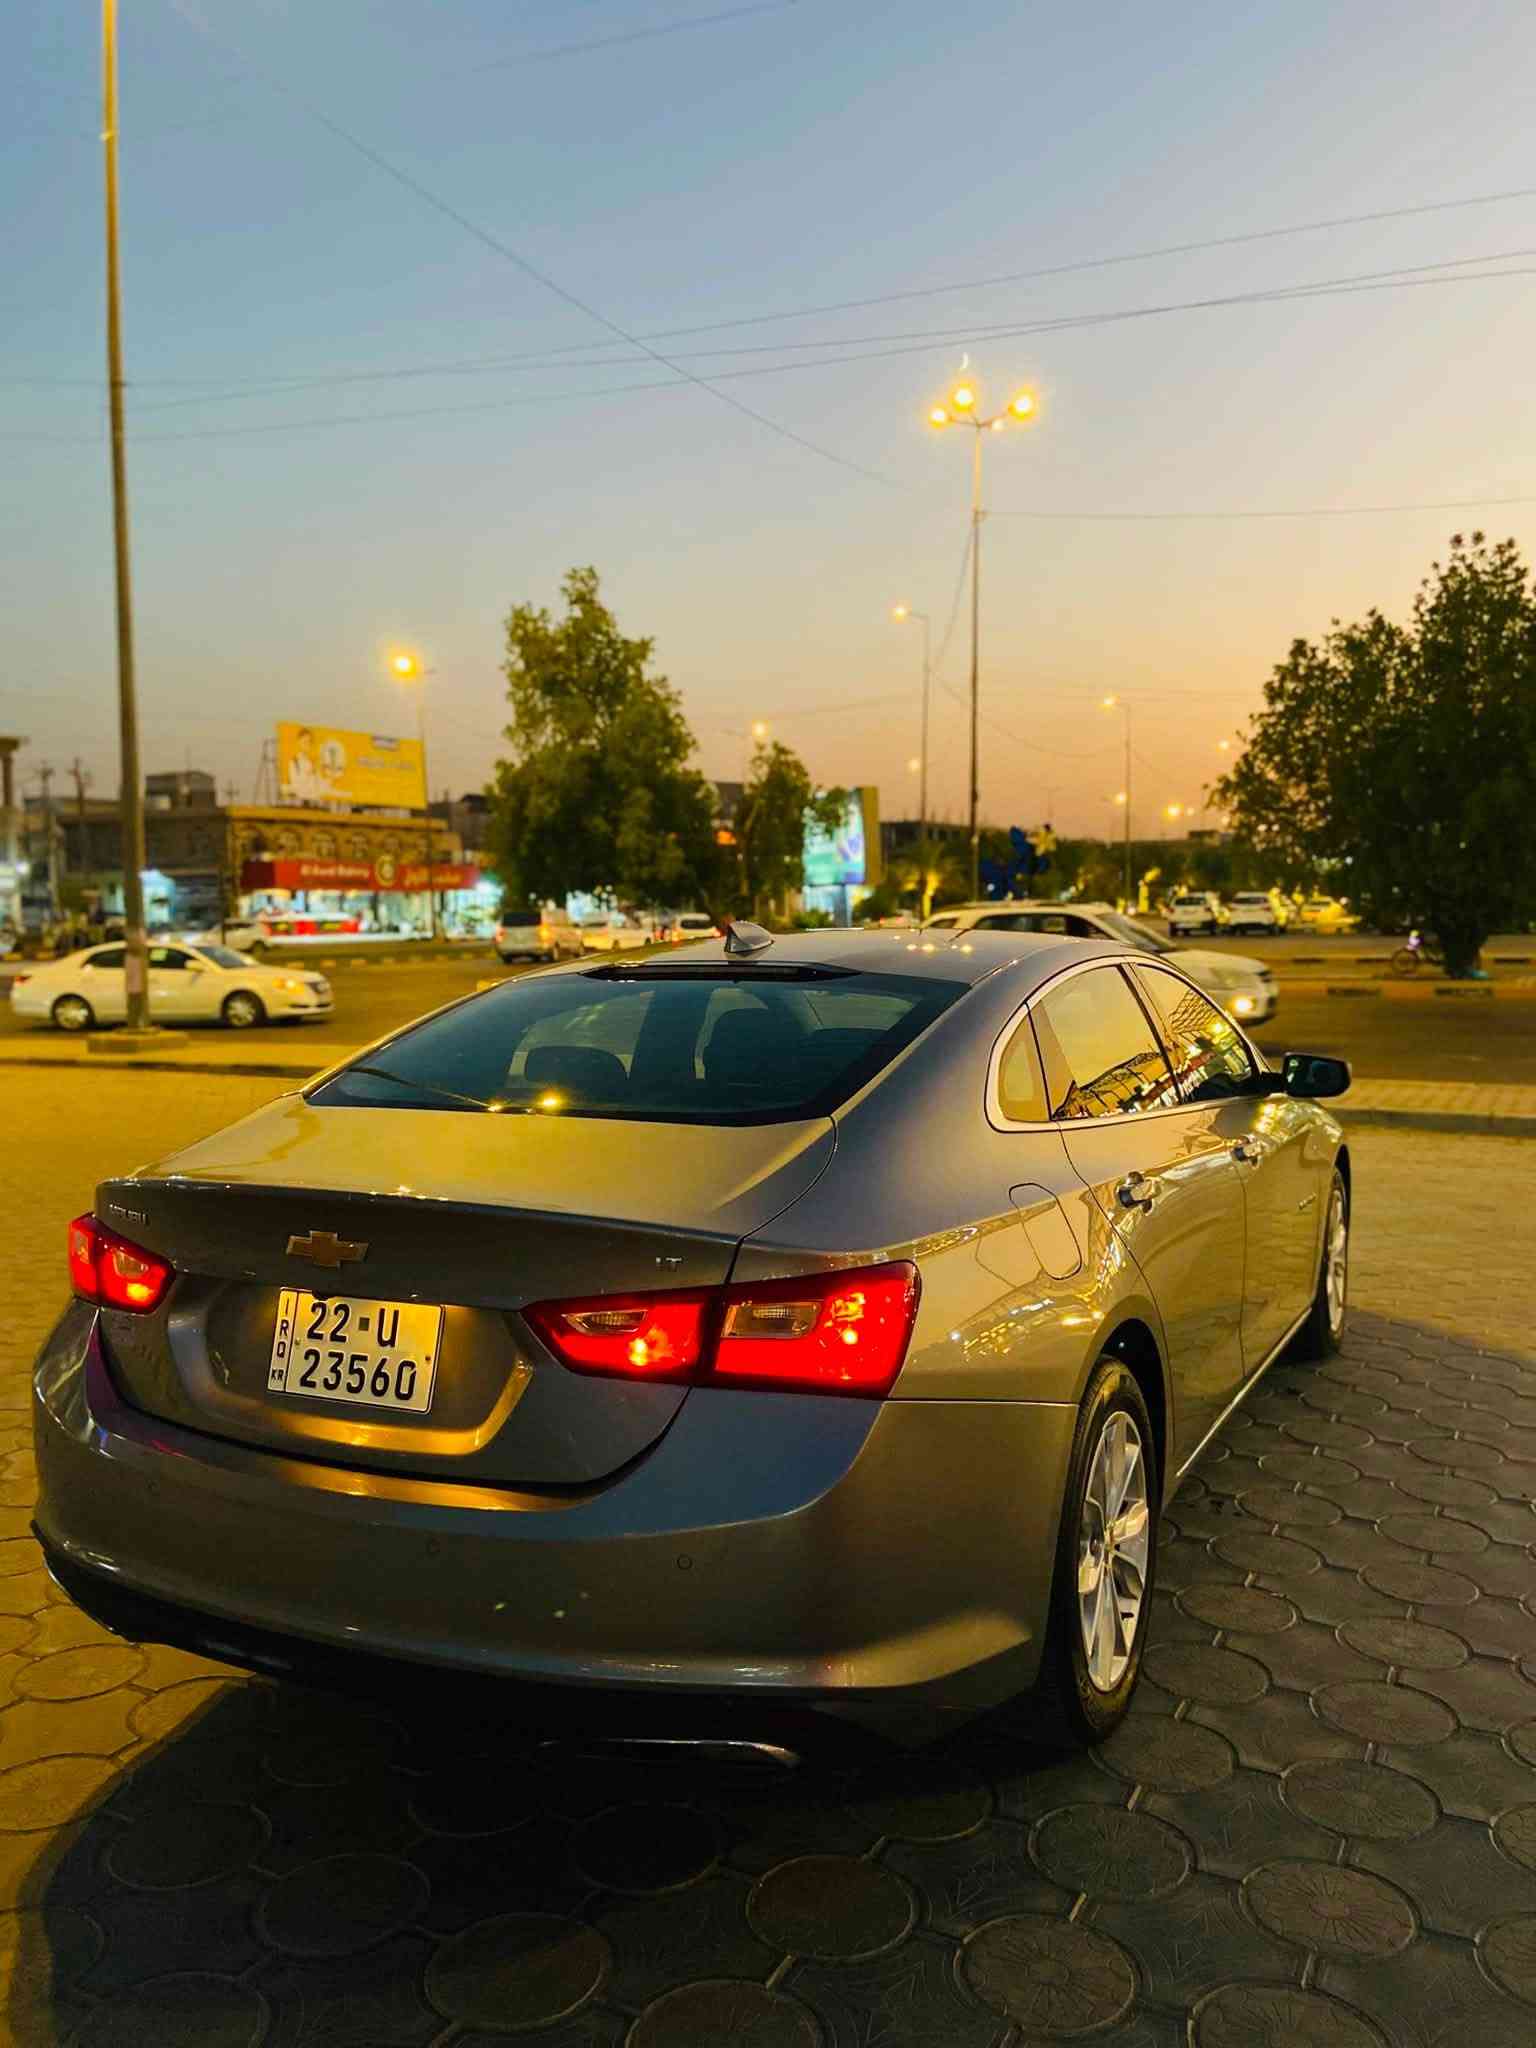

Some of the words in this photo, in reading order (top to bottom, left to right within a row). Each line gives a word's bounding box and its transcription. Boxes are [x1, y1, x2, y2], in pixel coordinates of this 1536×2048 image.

[307, 1301, 350, 1343] 22
[377, 1308, 400, 1348] U
[300, 1349, 417, 1400] 23560
